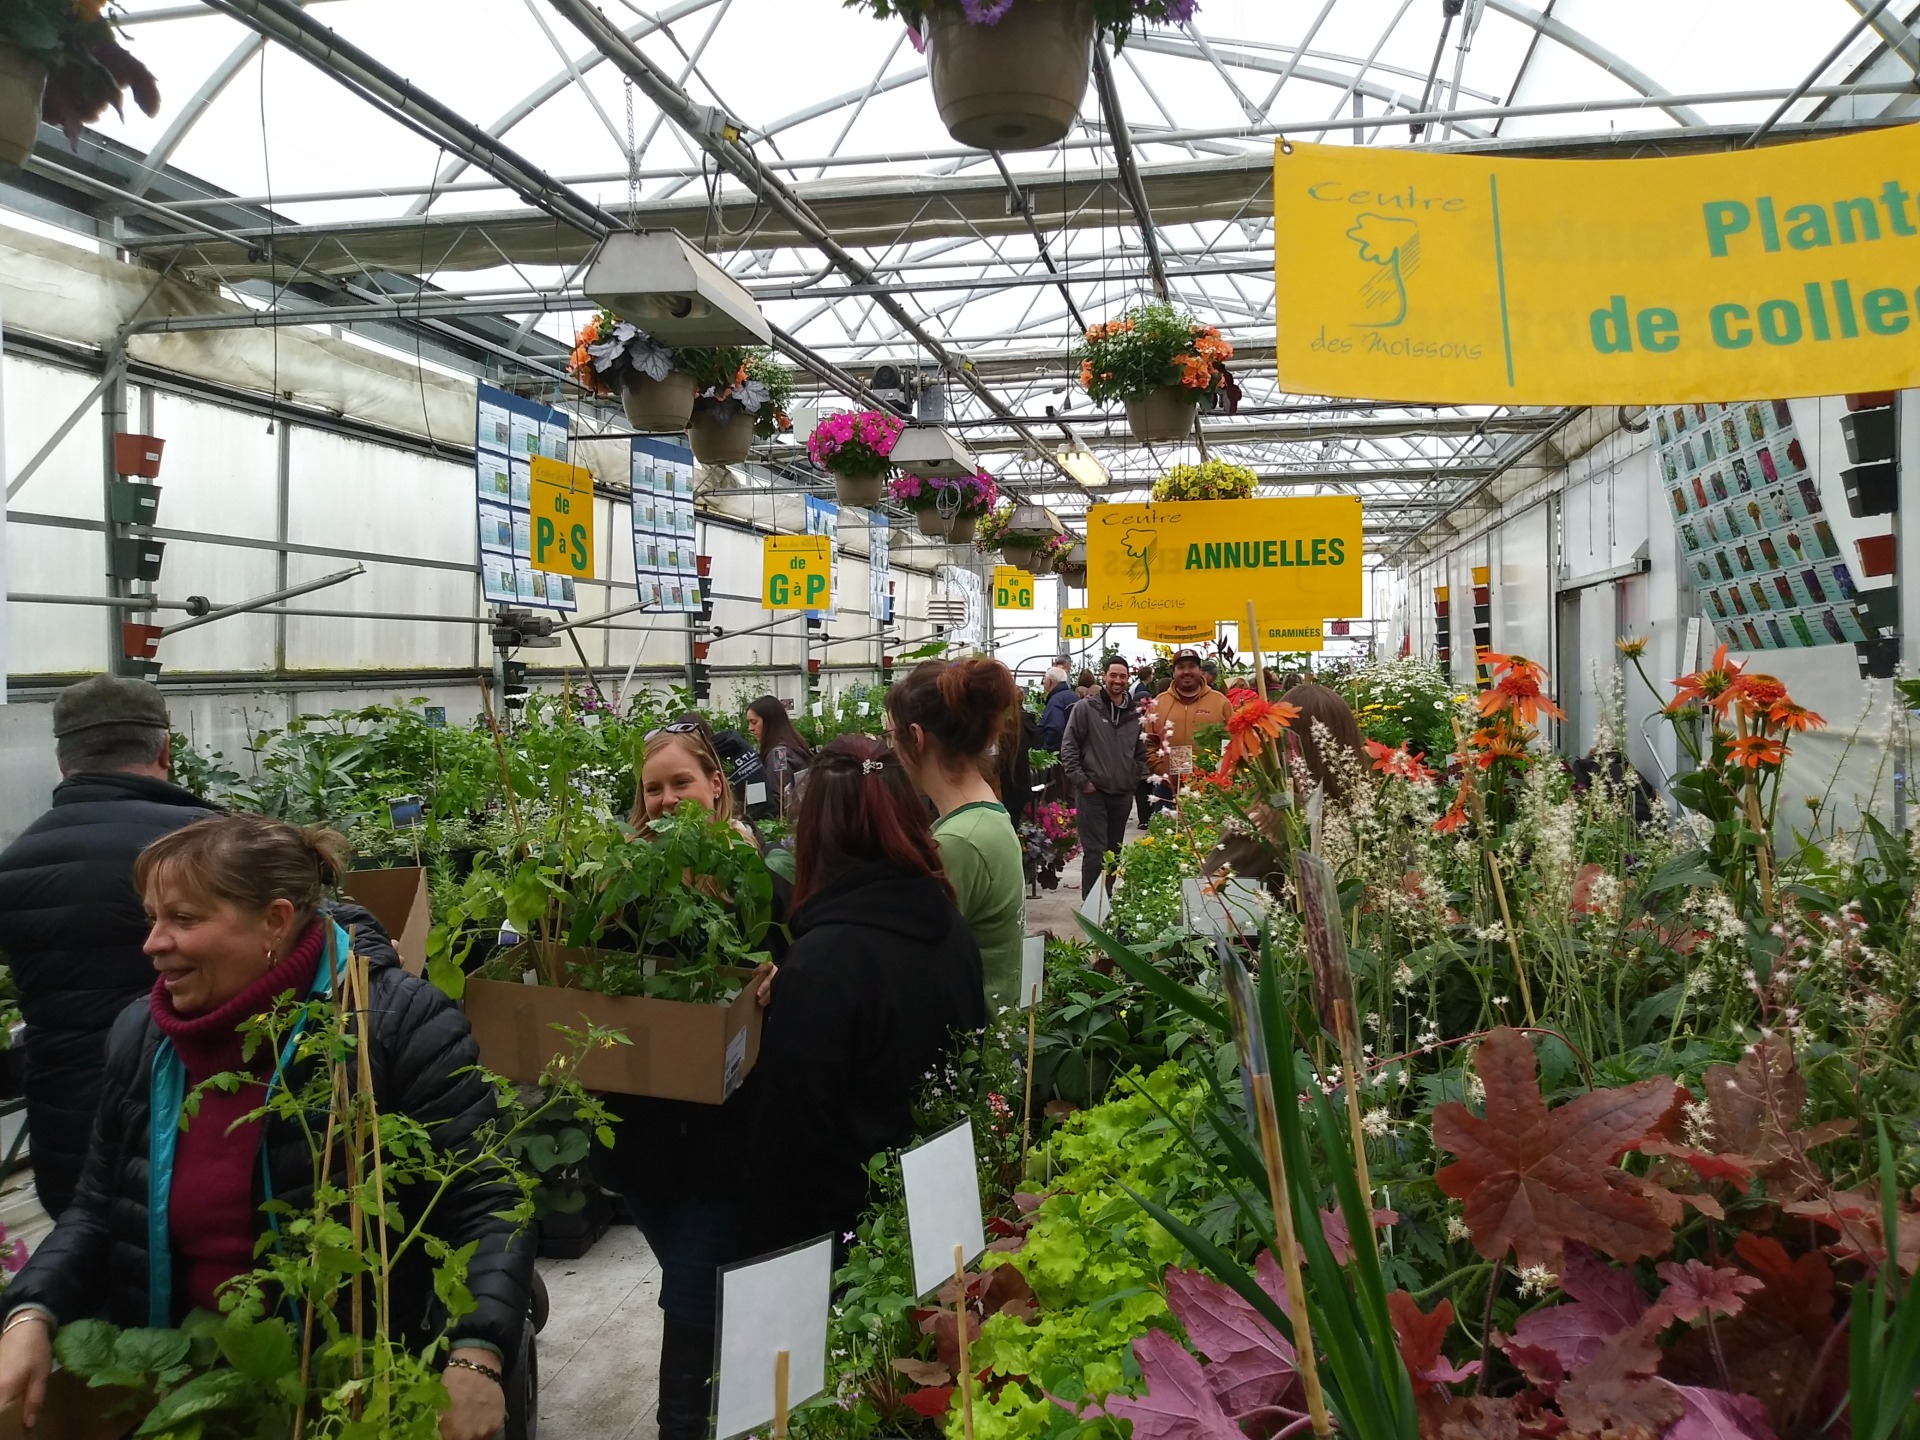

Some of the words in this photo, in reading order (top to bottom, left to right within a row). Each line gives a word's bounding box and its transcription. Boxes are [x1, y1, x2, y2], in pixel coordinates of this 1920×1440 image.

[1308, 182, 1467, 212] Centre
[1703, 180, 1920, 257] Plant
[1589, 295, 1680, 354] de
[1709, 279, 1920, 350] colle
[1310, 325, 1352, 353] des
[1361, 331, 1482, 360] Moissons
[555, 493, 570, 514] de
[1102, 510, 1183, 526] Centre
[537, 516, 555, 564] P
[559, 532, 566, 554] à
[570, 523, 587, 571] S
[1185, 538, 1345, 570] ANNUELLES
[790, 556, 806, 569] de
[769, 573, 789, 605] G
[793, 582, 802, 596] à
[806, 574, 826, 605] P
[1009, 577, 1019, 586] de
[997, 588, 1009, 607] D
[1011, 593, 1017, 601] à
[1019, 588, 1031, 607] G
[1102, 595, 1124, 610] des
[1128, 595, 1186, 610] Moissons
[1064, 624, 1074, 638] A
[1081, 623, 1090, 637] D
[1269, 626, 1321, 638] GRAMINÉES
